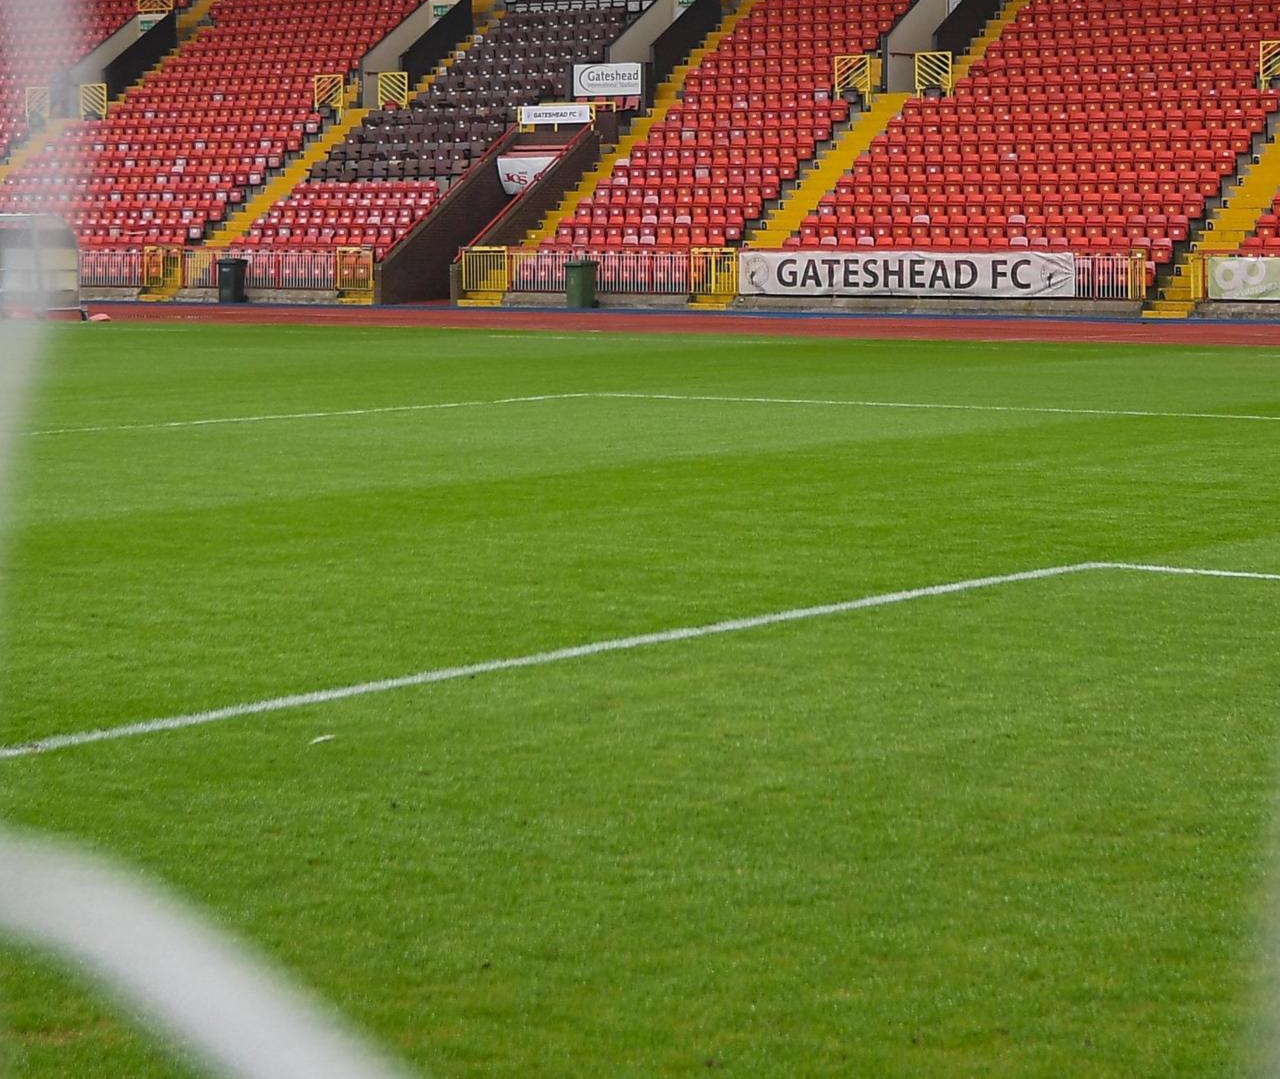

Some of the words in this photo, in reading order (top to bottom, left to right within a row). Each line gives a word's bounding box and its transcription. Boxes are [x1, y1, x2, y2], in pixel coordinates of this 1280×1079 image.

[587, 70, 638, 81] Gateshead
[776, 259, 978, 289] GATESHEAD
[991, 259, 1032, 290] FC
